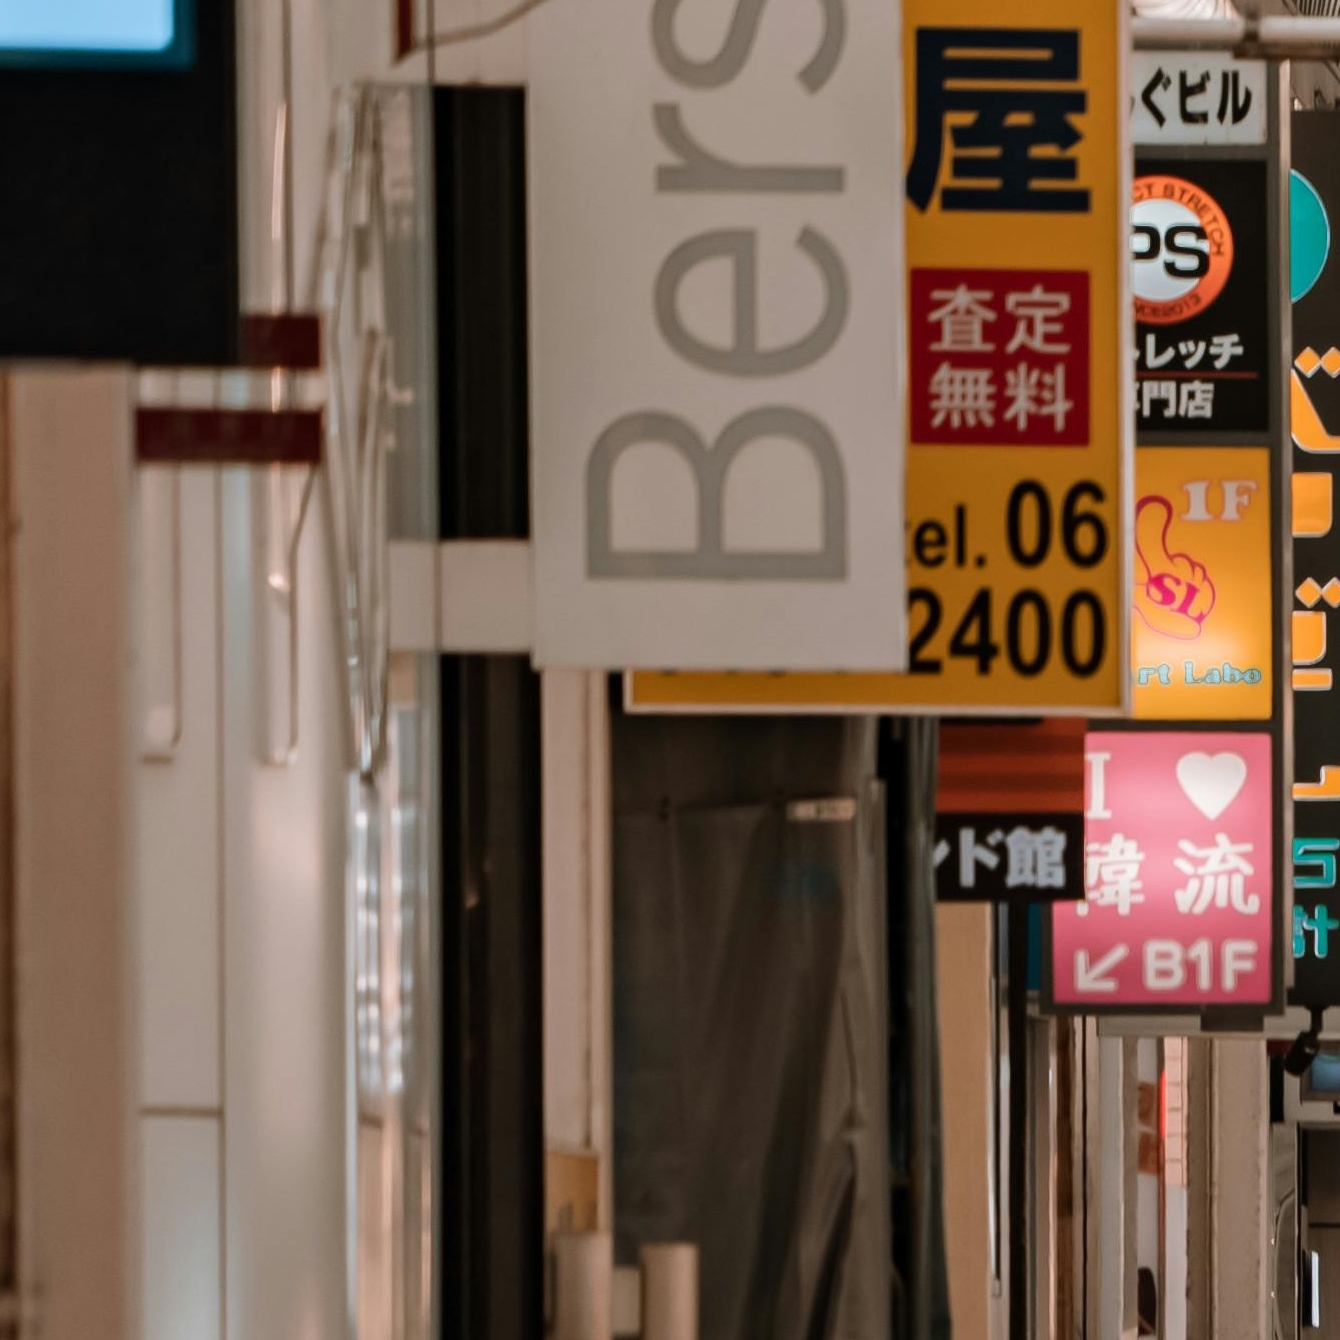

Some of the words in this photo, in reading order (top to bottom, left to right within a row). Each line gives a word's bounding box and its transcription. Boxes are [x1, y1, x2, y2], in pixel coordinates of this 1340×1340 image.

[905, 27, 1091, 216] 屋
[1130, 67, 1253, 128] ぐビル
[928, 284, 1071, 354] 査定
[1133, 333, 1244, 370] レッチ
[928, 362, 1073, 431] 無料
[1134, 380, 1215, 419] 門店
[905, 502, 987, 567] el.
[1007, 480, 1108, 568] 06
[1180, 480, 1258, 521] 1F
[907, 589, 1107, 678] 2400
[1132, 663, 1172, 685] rt
[1183, 661, 1262, 685] Labo
[934, 827, 1068, 890] ド館
[1144, 940, 1256, 990] B1F
